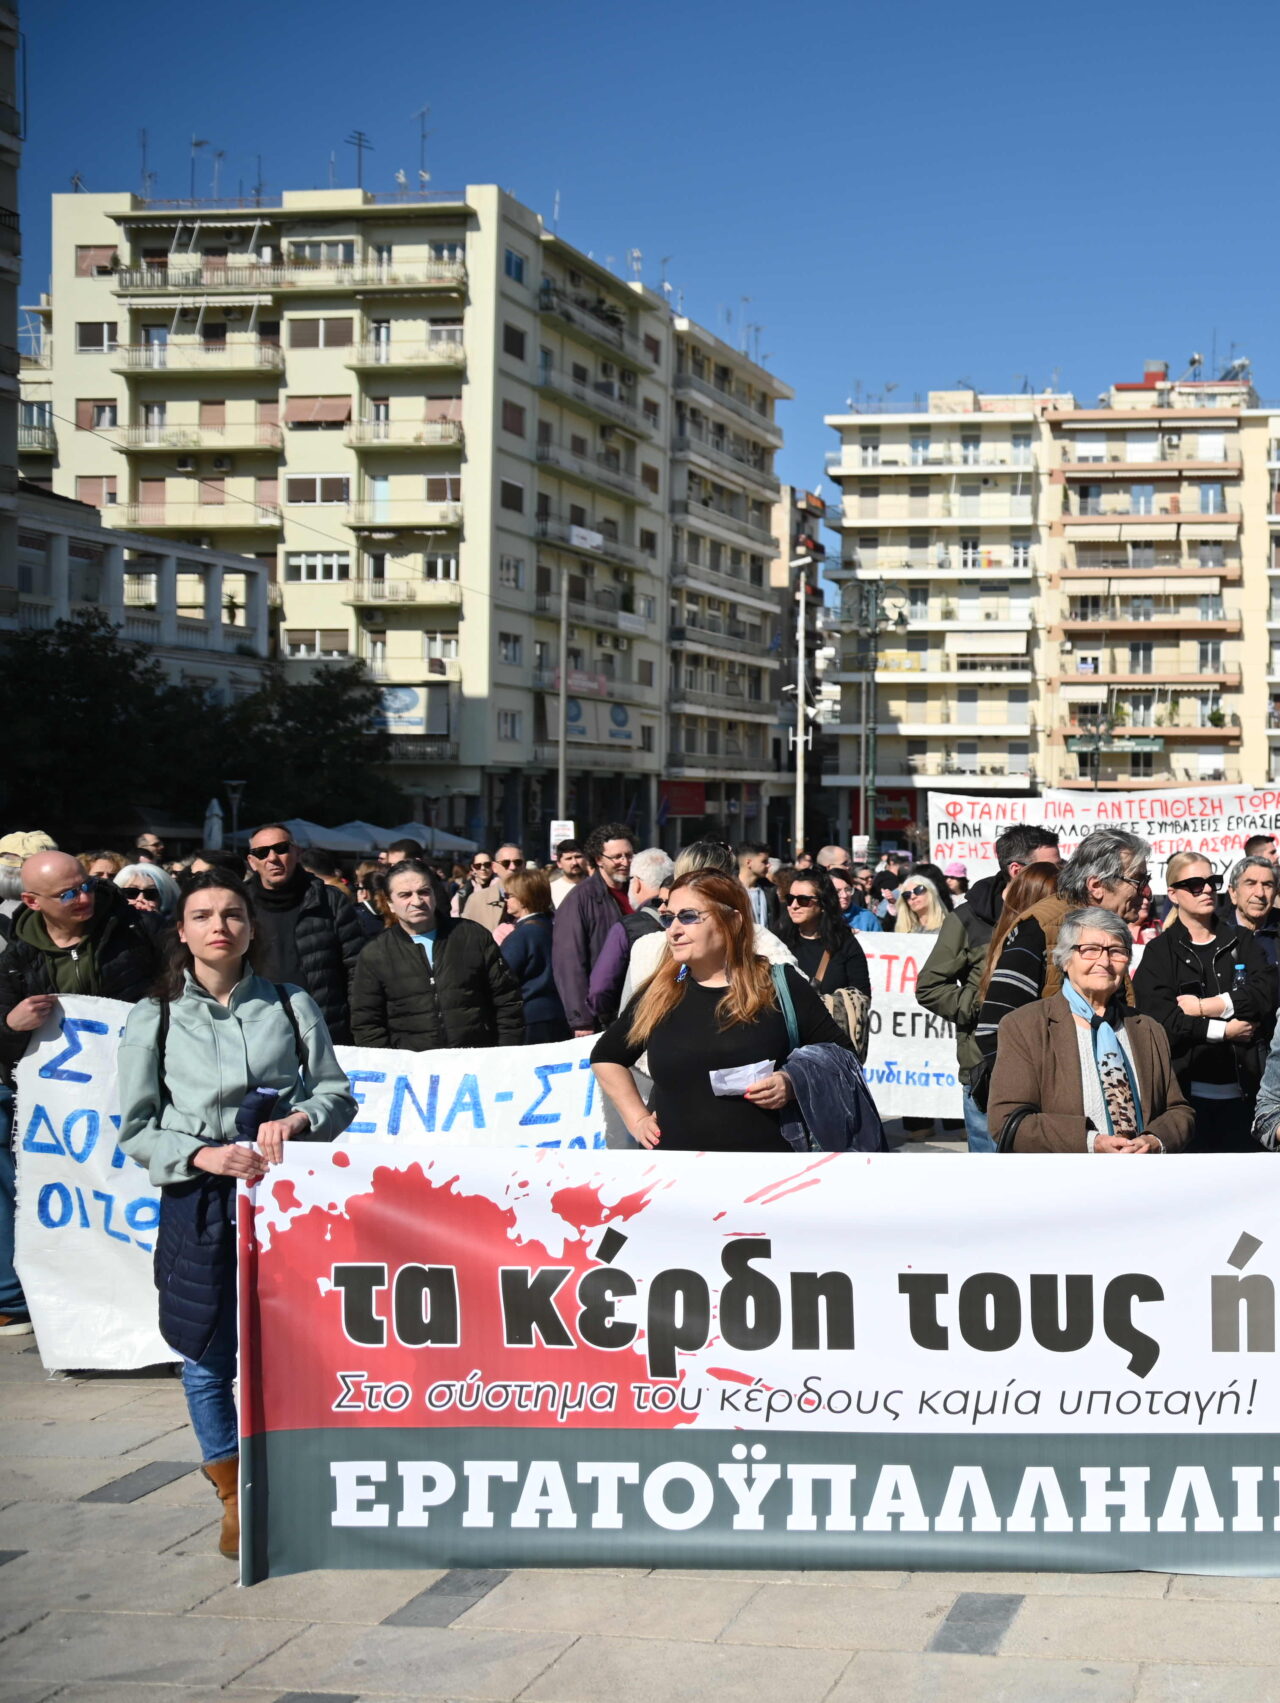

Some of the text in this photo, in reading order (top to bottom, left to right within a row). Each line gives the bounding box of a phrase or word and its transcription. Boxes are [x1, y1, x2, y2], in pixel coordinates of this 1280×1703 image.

[945, 800, 1027, 821] ΦΤΑΝΕΙ
[1044, 801, 1076, 820] ΠΙΑ
[1096, 796, 1224, 821] ΑΝΤΕΠΙΘΕΣΗ
[892, 1010, 957, 1040] ΕΓΚΛ
[863, 1060, 956, 1087] υνδικάτο
[332, 1262, 461, 1348] τα
[498, 1226, 857, 1380] κέρδη
[897, 1271, 1166, 1380] τους
[1210, 1230, 1277, 1353] ή
[332, 1371, 412, 1412] Στο
[424, 1370, 618, 1421] σύστημα
[631, 1382, 703, 1412] του
[719, 1375, 904, 1422] κέρδους
[917, 1378, 1041, 1426] καμία
[1058, 1378, 1258, 1426] υποταγή!
